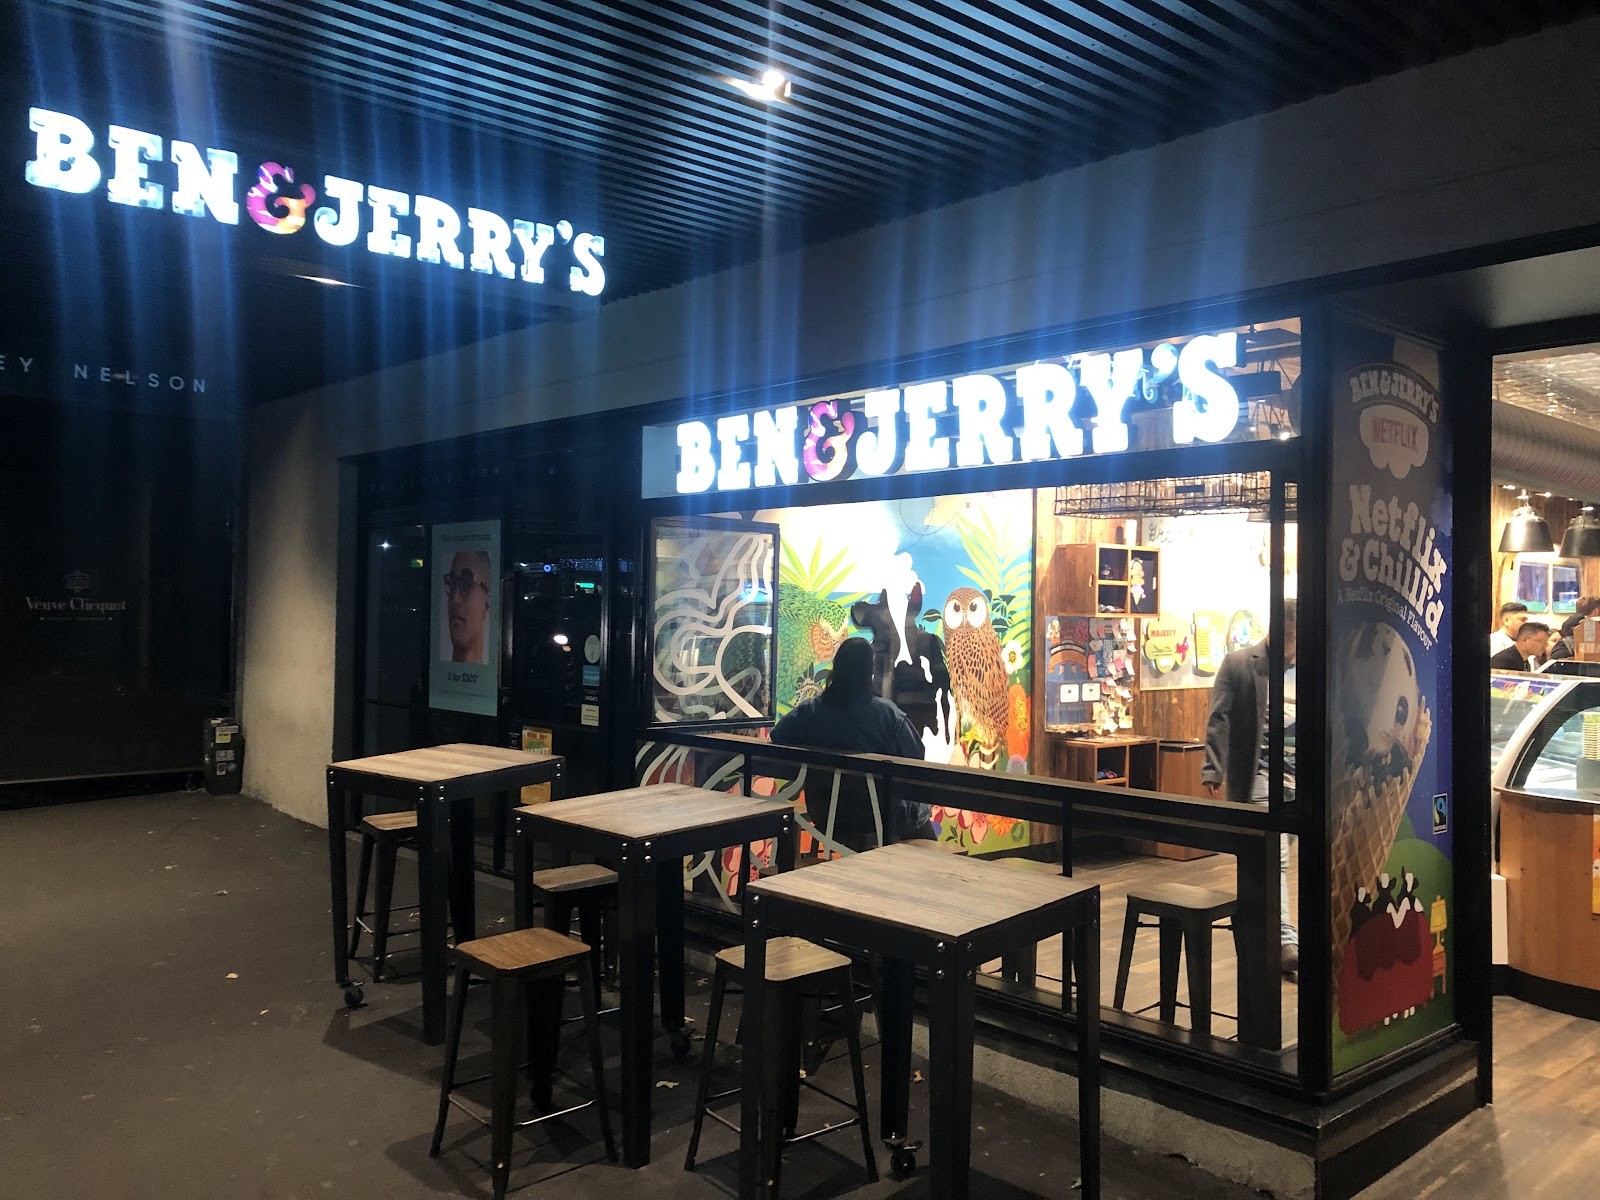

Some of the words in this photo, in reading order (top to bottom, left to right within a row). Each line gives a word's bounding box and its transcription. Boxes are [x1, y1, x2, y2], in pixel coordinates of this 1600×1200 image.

[73, 362, 207, 393] NELSON
[1370, 415, 1418, 453] NETFLIX
[1339, 537, 1361, 582] &
[1350, 484, 1448, 594] Netflix
[25, 596, 67, 611] Veuve
[68, 596, 128, 614] Clicquot
[1374, 588, 1408, 622] Original
[1406, 610, 1434, 651] Flavour
